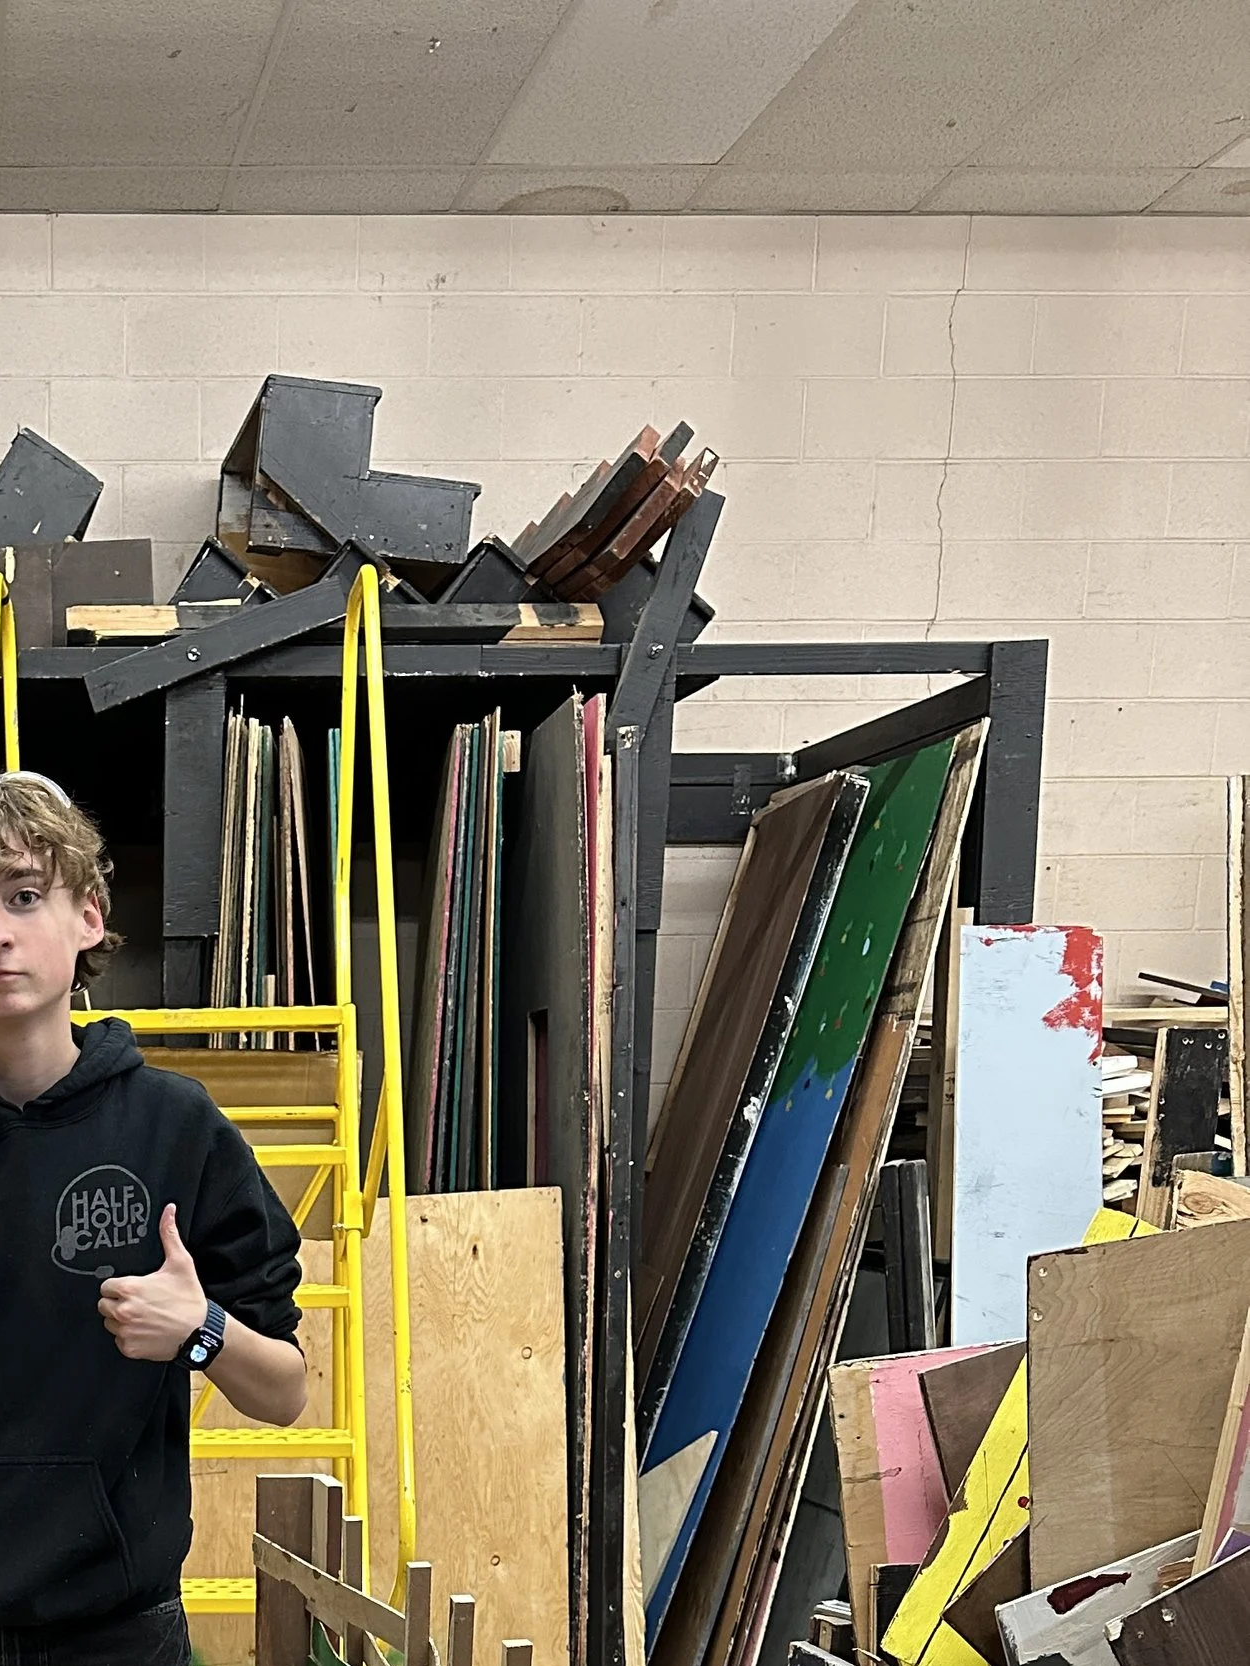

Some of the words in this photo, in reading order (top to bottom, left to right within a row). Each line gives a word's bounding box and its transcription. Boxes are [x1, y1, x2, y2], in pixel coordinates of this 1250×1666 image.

[71, 1185, 135, 1210] HALF
[72, 1202, 146, 1231] HOUR
[74, 1223, 140, 1251] CALL
